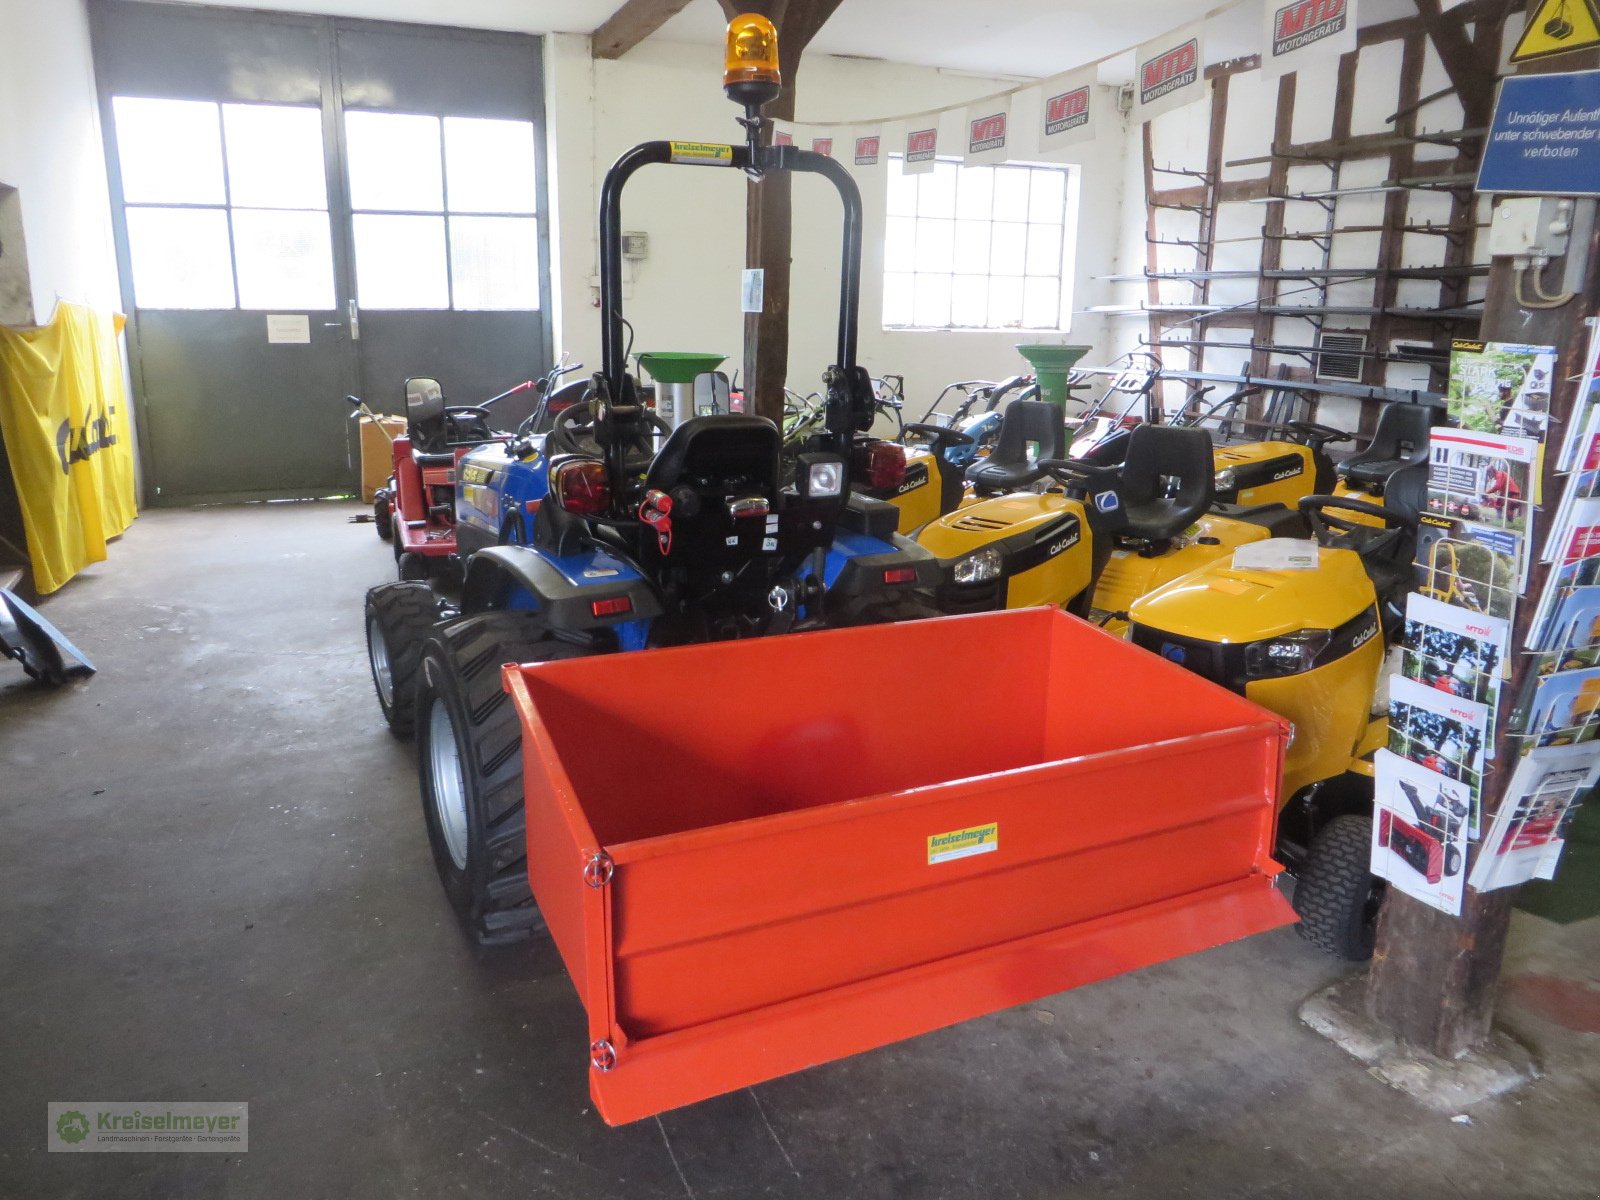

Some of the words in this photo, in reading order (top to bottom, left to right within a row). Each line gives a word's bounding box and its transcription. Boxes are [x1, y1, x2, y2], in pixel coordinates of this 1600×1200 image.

[1279, 0, 1345, 38] MTD
[1276, 18, 1342, 53] MOTORGERÄTE
[1143, 43, 1196, 87] MTD
[1143, 72, 1195, 102] MOTORGERÄTE
[1049, 89, 1088, 121] MTD
[1508, 110, 1560, 126] Unnötiger
[1560, 107, 1600, 122] Aufent
[972, 115, 1006, 143] MTD
[1494, 130, 1522, 141] unter
[1522, 127, 1597, 141] schwebender
[1524, 145, 1579, 158] verboten
[930, 827, 997, 848] kreiselmeyer
